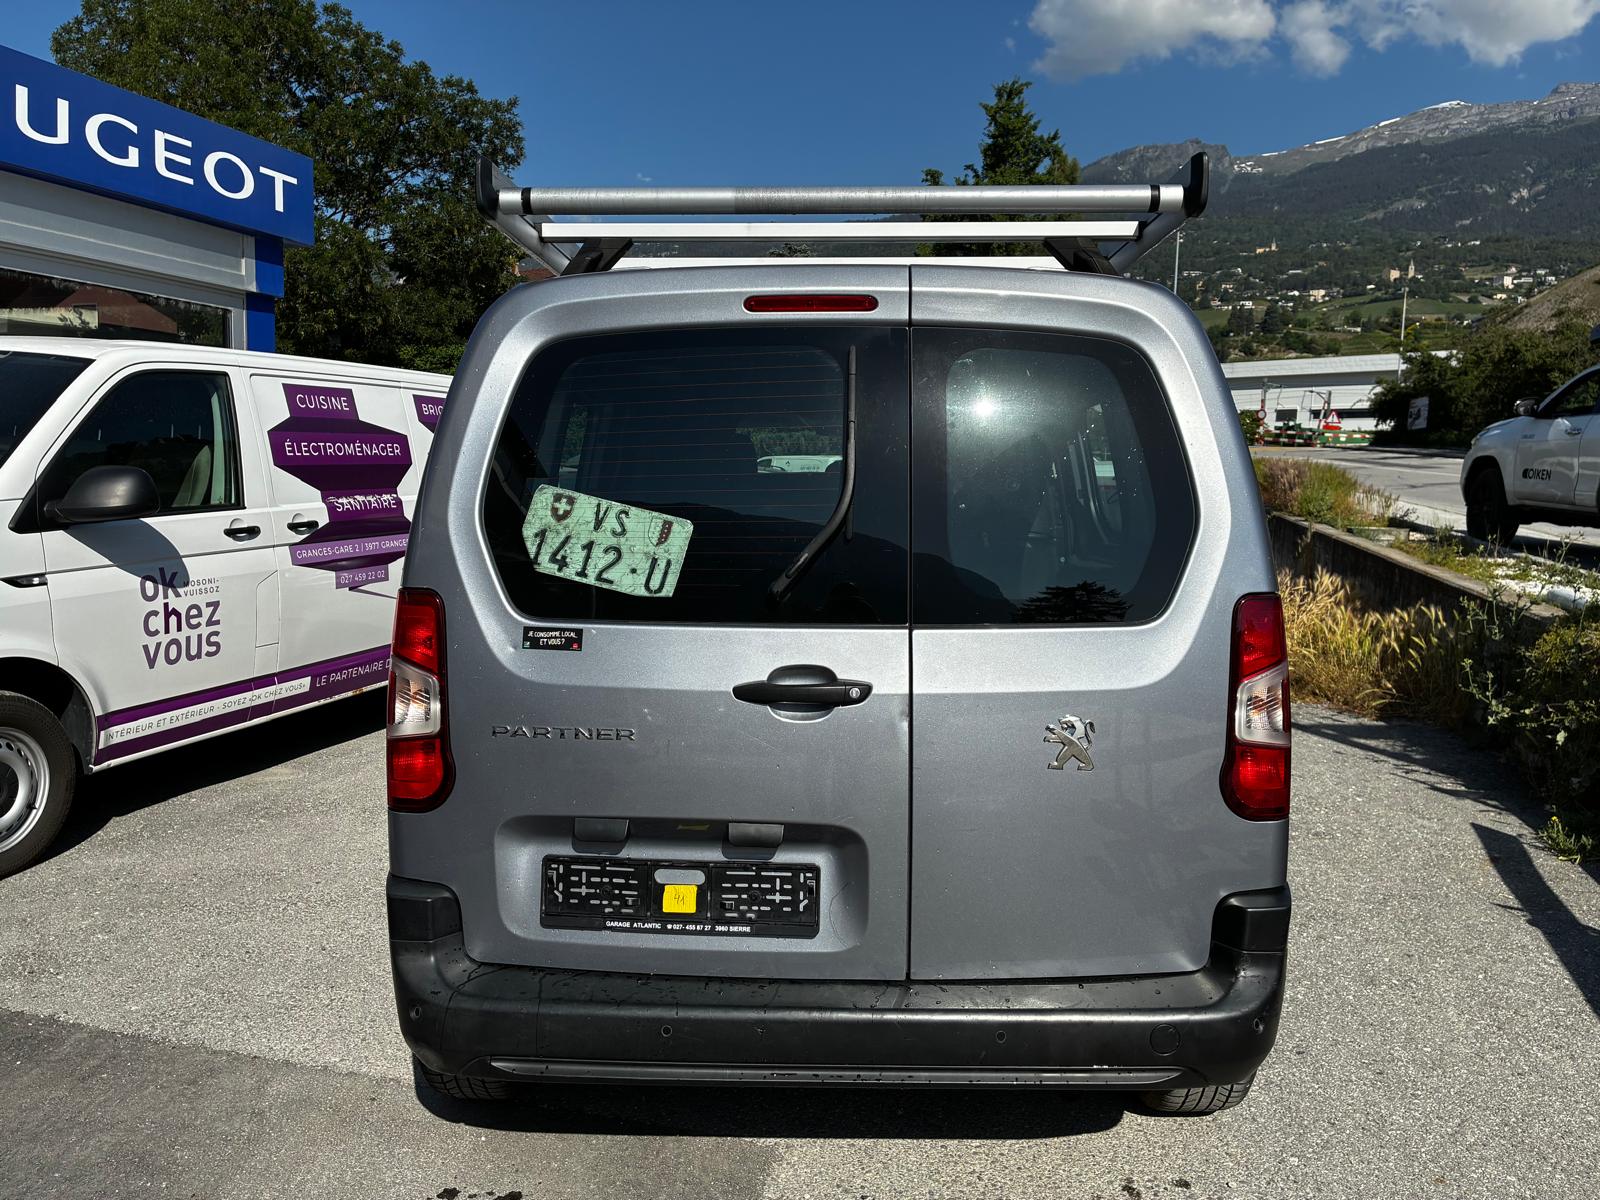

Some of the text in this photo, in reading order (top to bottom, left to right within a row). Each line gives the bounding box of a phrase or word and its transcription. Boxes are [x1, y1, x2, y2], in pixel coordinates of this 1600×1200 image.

[15, 83, 297, 213] UGEOT
[296, 394, 350, 411] CUISINE
[284, 438, 402, 456] ÉLECTROMÉNAGER
[334, 494, 398, 512] SANITAIRE
[593, 502, 630, 537] VS
[296, 545, 354, 559] GRANGES-GARE
[355, 544, 360, 552] 2
[365, 542, 380, 551] 3977
[340, 570, 386, 584] 027 459 22 02
[183, 586, 220, 597] VUISSOZ
[143, 600, 221, 637] chez
[142, 631, 221, 670] vous
[540, 638, 547, 646] ET
[316, 675, 327, 687] LE
[329, 660, 384, 683] PARTENAIRE
[156, 717, 167, 728] ET
[169, 705, 215, 724] EXTÉRIEUR
[222, 697, 247, 710] SOYEZ
[263, 688, 283, 697] CHEZ
[491, 725, 636, 741] PARTNER
[605, 920, 631, 928] GARAGE
[632, 921, 662, 929] ATLANTIC
